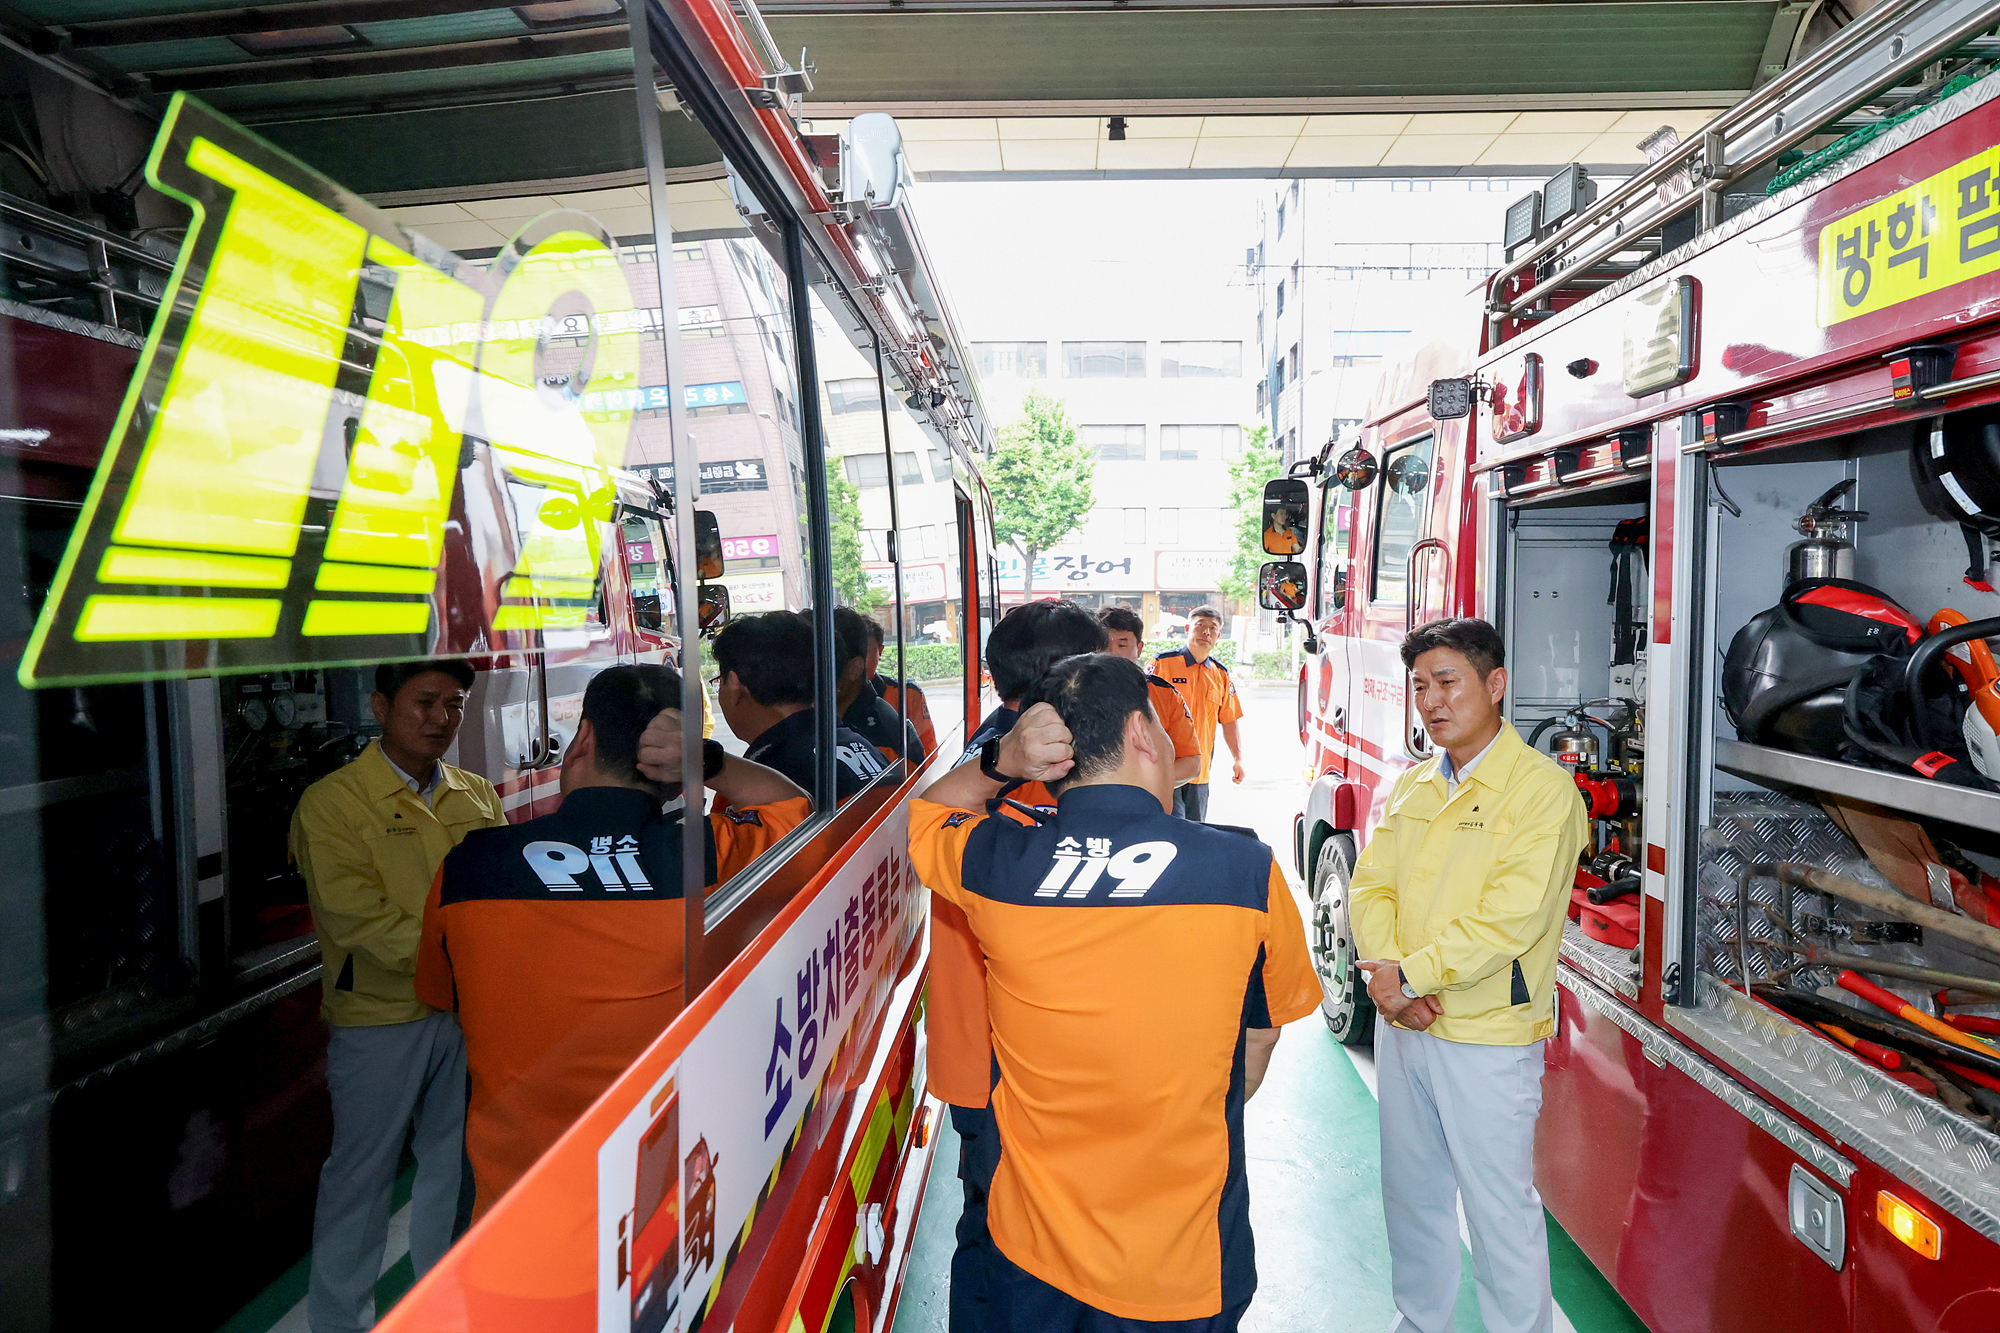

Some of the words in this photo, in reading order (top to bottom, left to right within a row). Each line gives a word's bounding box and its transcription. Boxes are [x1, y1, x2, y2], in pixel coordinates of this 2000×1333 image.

[1836, 195, 1936, 308] 방학
[1033, 840, 1178, 899] 119
[1054, 836, 1113, 858] 소방
